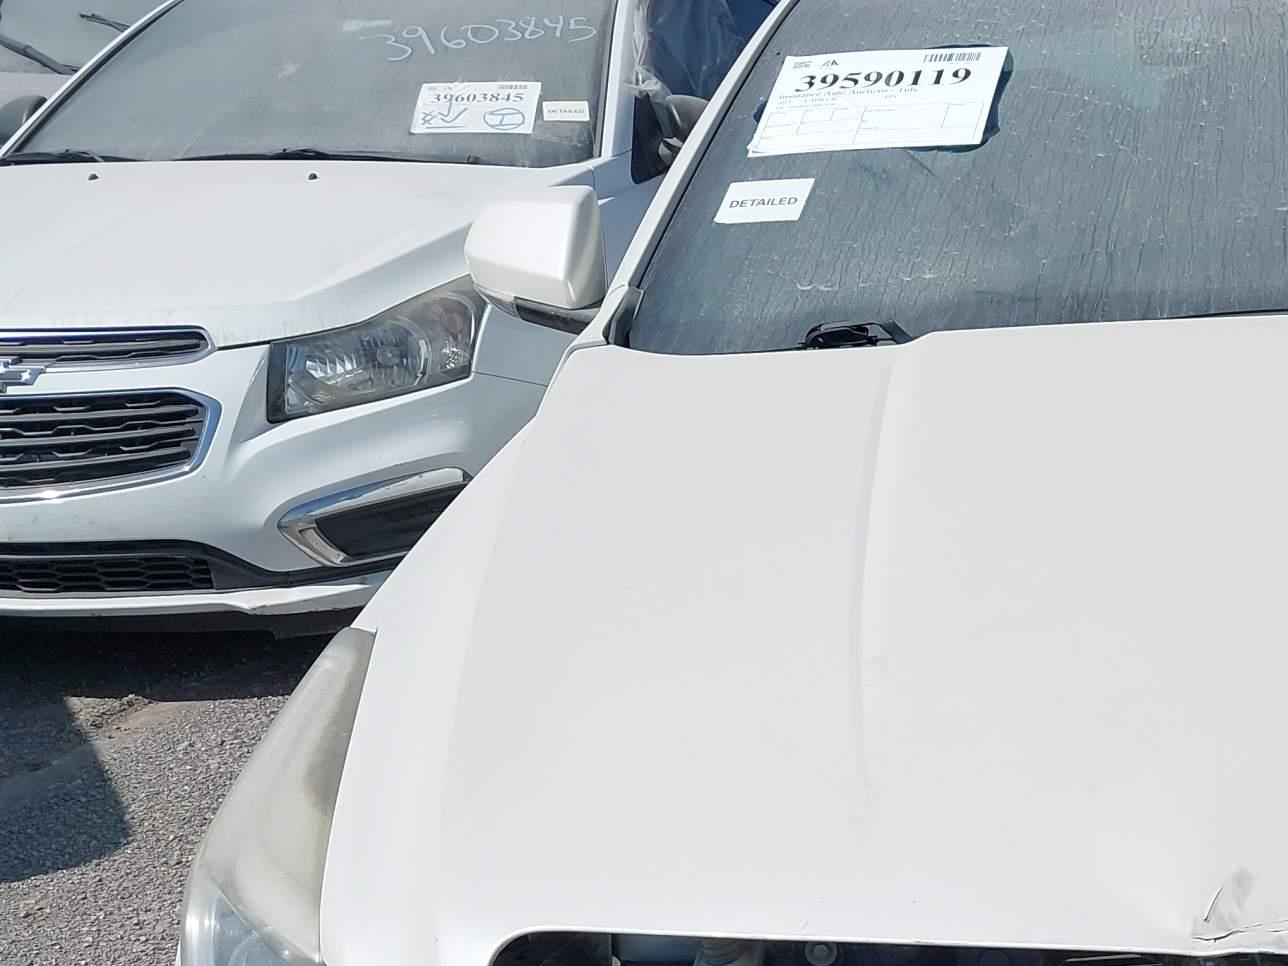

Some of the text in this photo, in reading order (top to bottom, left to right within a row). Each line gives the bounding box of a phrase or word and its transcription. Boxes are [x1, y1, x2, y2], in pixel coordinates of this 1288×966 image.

[360, 15, 597, 61] 39603845
[794, 67, 973, 92] 39590119
[429, 92, 525, 104] 39603845
[728, 196, 799, 210] DETAILED
